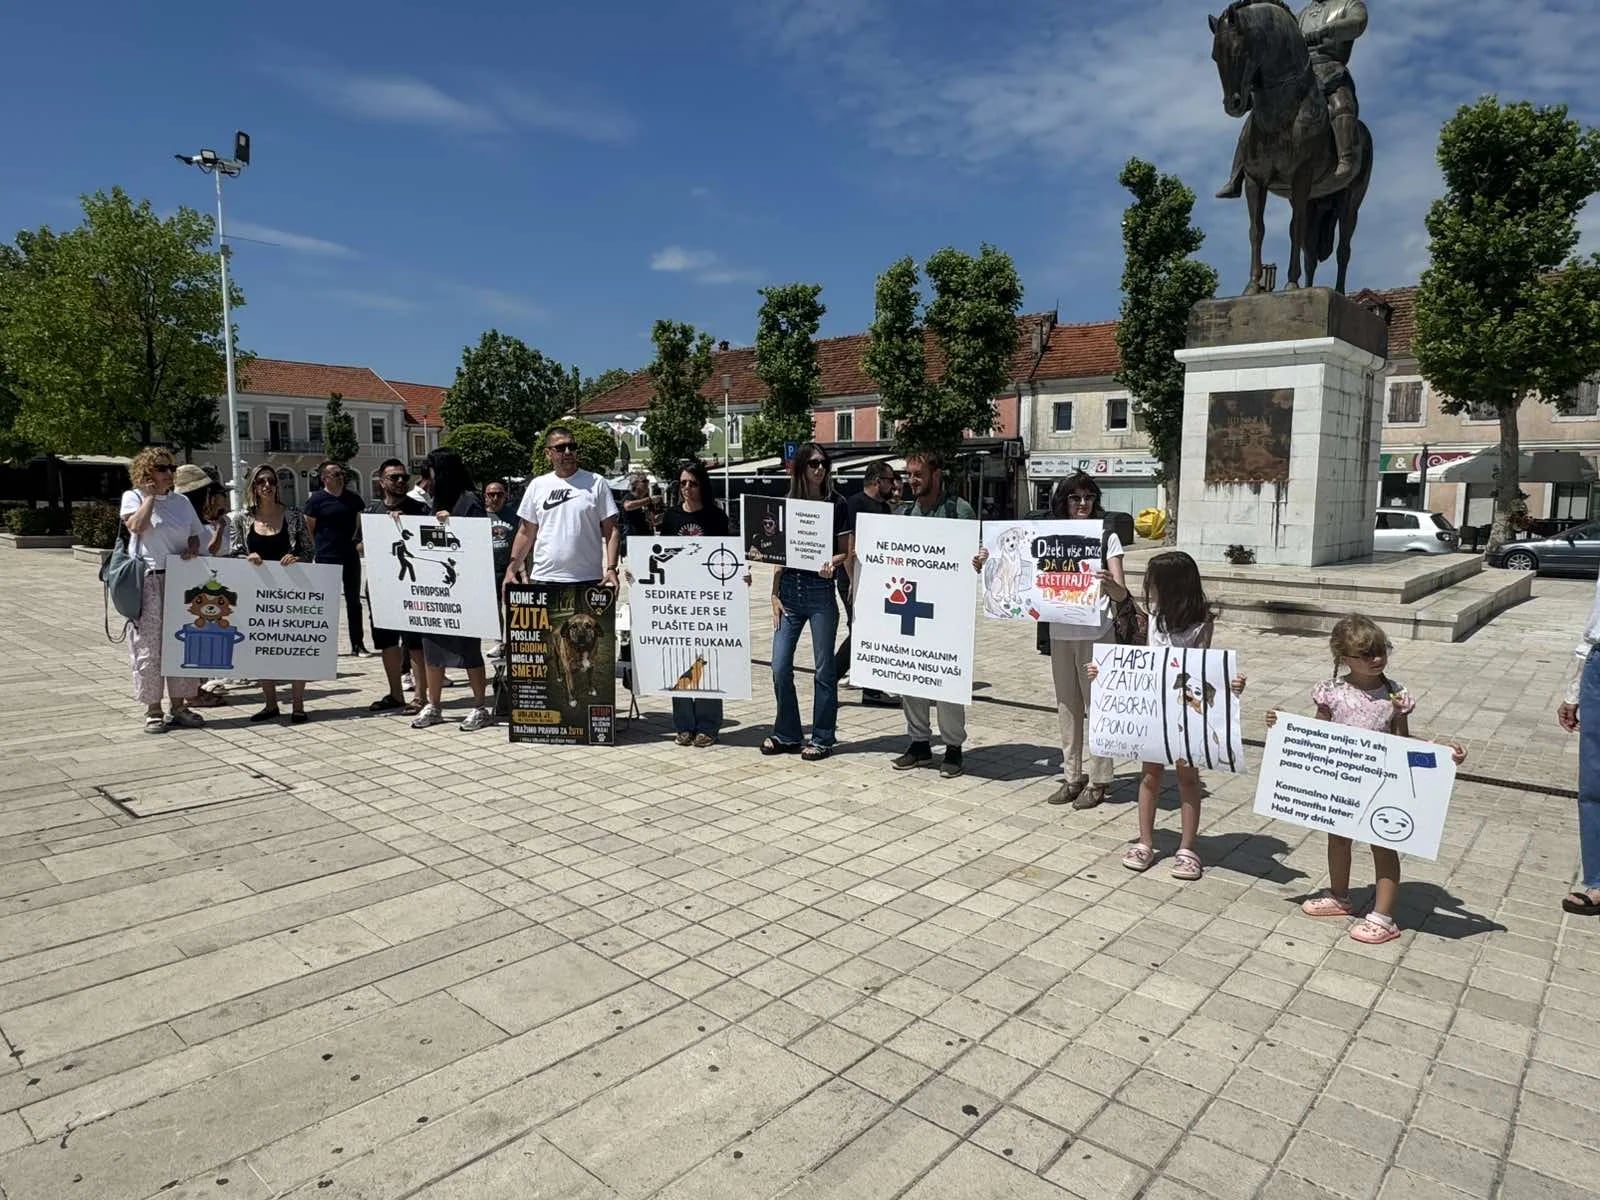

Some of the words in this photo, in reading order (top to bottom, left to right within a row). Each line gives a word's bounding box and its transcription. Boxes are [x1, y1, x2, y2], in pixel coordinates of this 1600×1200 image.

[549, 488, 572, 501] NIKE
[876, 540, 889, 550] NE
[891, 542, 920, 553] DAMO
[922, 545, 946, 556] VAM
[866, 554, 884, 564] NAŠ
[886, 556, 904, 566] TNR
[906, 558, 959, 572] PROGRAM!
[1043, 559, 1057, 572] DA
[1062, 559, 1076, 572] GA
[1040, 574, 1091, 588] TRETIRAJU
[308, 592, 324, 600] PSI
[411, 585, 450, 598] EVROPSKA
[510, 592, 534, 604] KOME
[536, 592, 548, 605] JE
[644, 590, 696, 600] SEDIRATE
[700, 591, 720, 600] PSE
[723, 591, 733, 600] IZ
[256, 604, 284, 614] NISU
[652, 604, 688, 616] PUŠKE
[690, 606, 710, 616] JER
[713, 607, 726, 616] SE
[249, 618, 265, 627] DA
[268, 618, 280, 628] IH
[409, 616, 442, 628] KULTURE
[444, 618, 460, 629] VELI
[510, 604, 552, 632] ŽUTA,
[652, 620, 694, 631] PLAŠITE
[698, 622, 714, 632] DA
[716, 622, 728, 632] IH
[249, 632, 327, 643] KOMUNALNO
[510, 630, 540, 641] POSLIJE
[640, 636, 692, 646] UHVATITE
[694, 638, 742, 648] RUKAMA
[256, 646, 320, 657] PREDUZEĆE
[520, 642, 548, 654] GODINA
[860, 640, 872, 650] PSI
[874, 642, 880, 650] U
[882, 643, 910, 656] NAŠIM
[911, 649, 958, 662] LOKALNIM
[512, 654, 534, 664] MOGLA
[535, 654, 544, 664] DA
[856, 652, 916, 670] ZAJEDNICAMA
[918, 660, 939, 674] NISU
[940, 664, 962, 676] VAŠI
[1113, 646, 1155, 671] HAPSI
[512, 664, 548, 678] SMETA?
[872, 668, 910, 682] POLITIČKI
[1106, 670, 1158, 692] ZATVORI
[1101, 718, 1148, 736] PONOVI
[1286, 723, 1329, 740] Evropska
[1331, 733, 1358, 746] unija:
[1360, 738, 1371, 748] Vi
[1372, 742, 1388, 752] ste
[1284, 736, 1327, 752] pozitivan
[1328, 745, 1363, 761] primjer
[1365, 754, 1377, 762] za
[1282, 747, 1335, 766] upravljanje
[1336, 759, 1398, 780] populacijom
[1280, 760, 1303, 771] pasa
[1304, 764, 1311, 772] u
[1312, 764, 1338, 780] Crnoj
[1340, 772, 1363, 784] Gori
[1275, 780, 1328, 801] Komunalno
[1330, 794, 1360, 808] Nikšić
[1274, 792, 1290, 803] two
[1292, 796, 1327, 812] months
[1328, 805, 1354, 819] later:
[1271, 803, 1293, 816] Hold
[1294, 810, 1310, 822] my
[1311, 813, 1336, 827] drink
